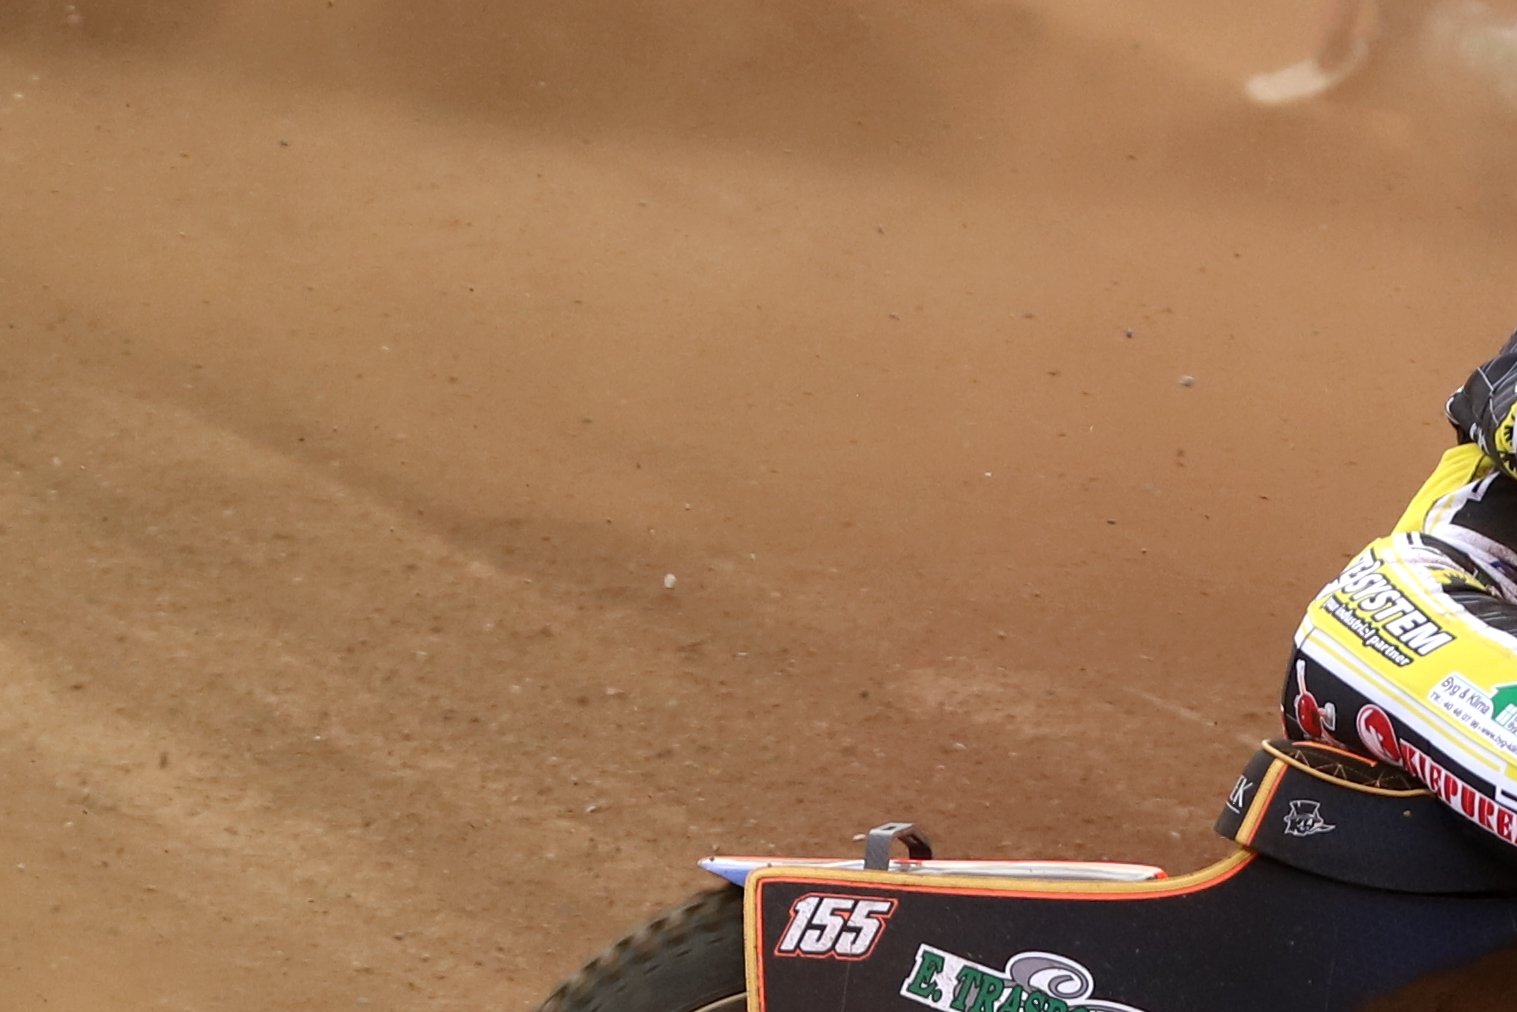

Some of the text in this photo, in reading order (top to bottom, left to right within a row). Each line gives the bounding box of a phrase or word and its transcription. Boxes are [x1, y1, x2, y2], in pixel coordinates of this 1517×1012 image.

[1363, 632, 1414, 667] partner
[1441, 676, 1491, 715] Byg & Klima
[778, 897, 896, 955] 155
[907, 950, 945, 1001] E.
